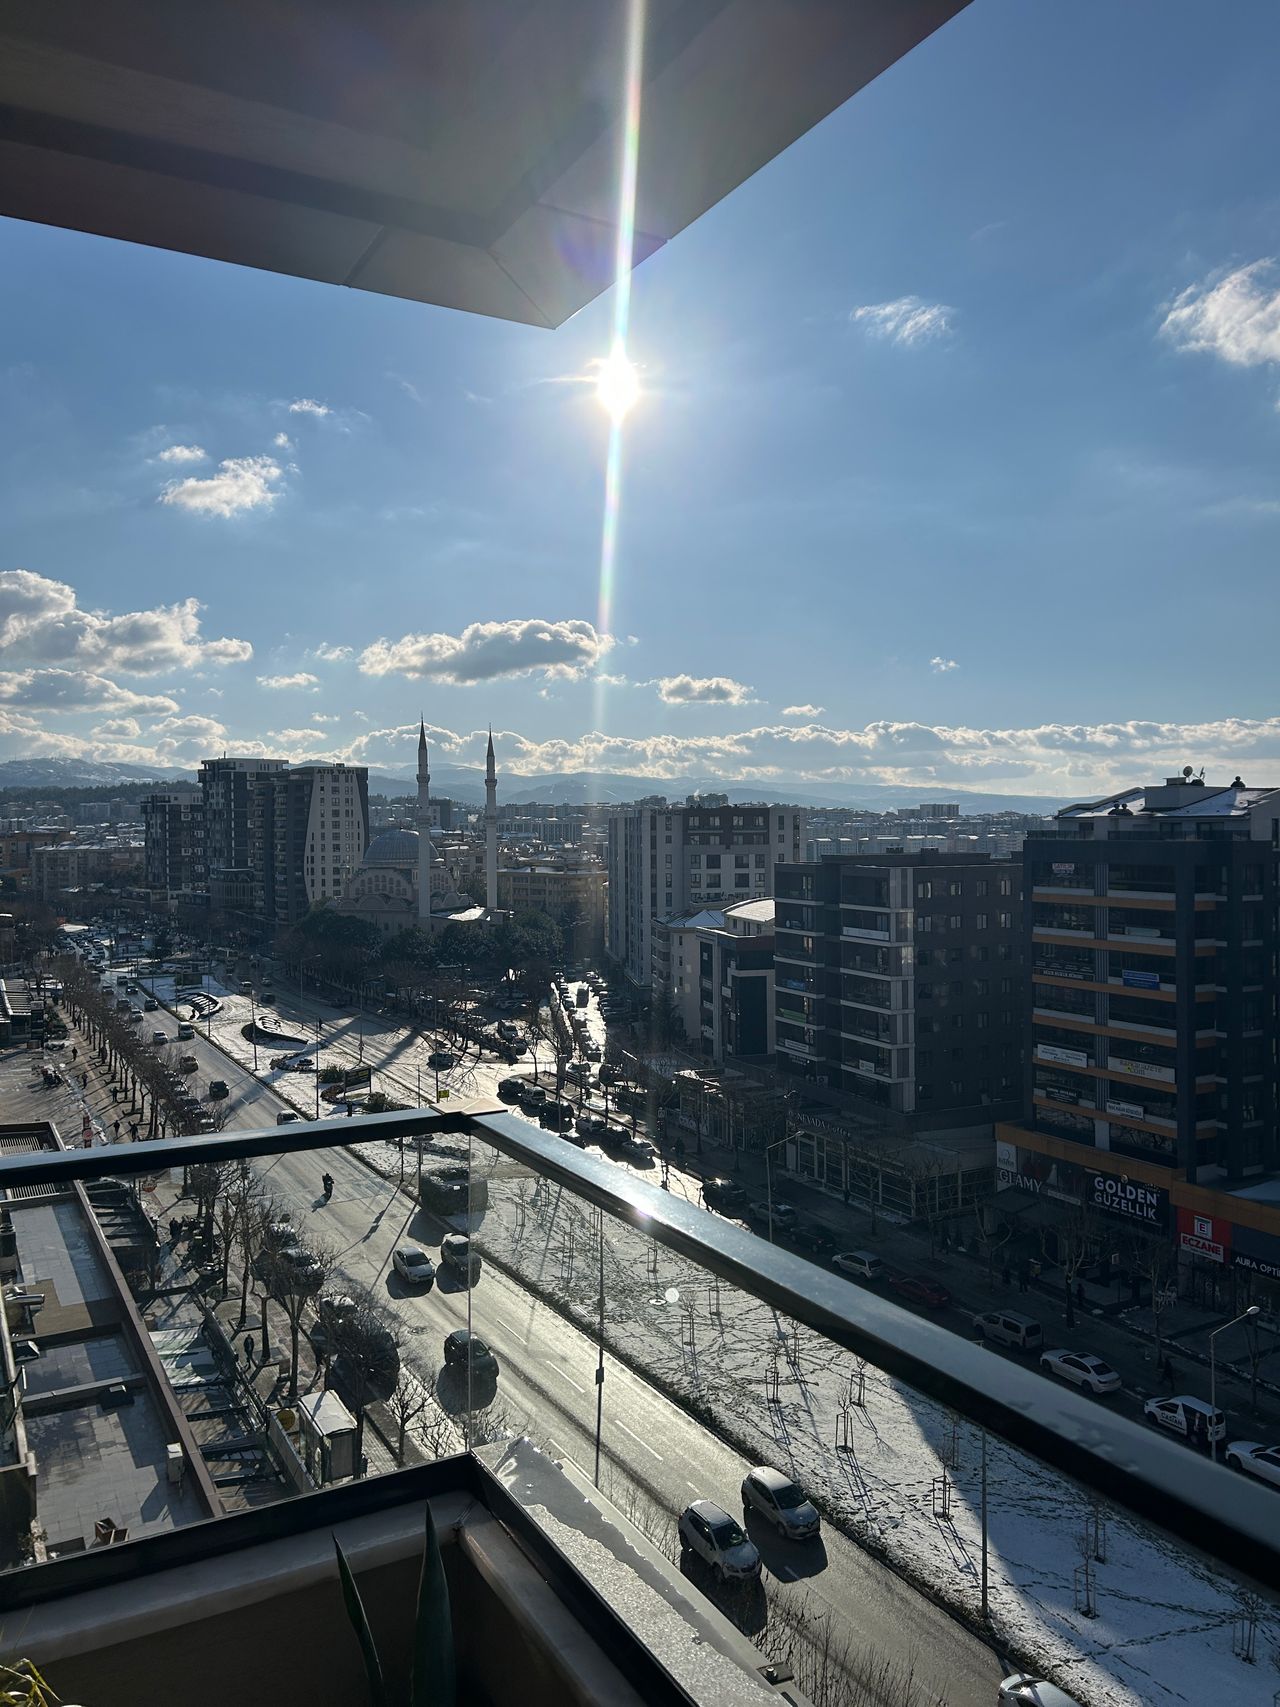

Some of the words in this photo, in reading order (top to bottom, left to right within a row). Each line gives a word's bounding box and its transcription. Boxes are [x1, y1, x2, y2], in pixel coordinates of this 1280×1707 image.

[1094, 1176, 1158, 1206] GOLDEN
[1094, 1191, 1157, 1220] GÜZELLİK
[1199, 1223, 1206, 1232] E
[1182, 1235, 1222, 1256] ECZANE
[1235, 1256, 1258, 1270] AURA
